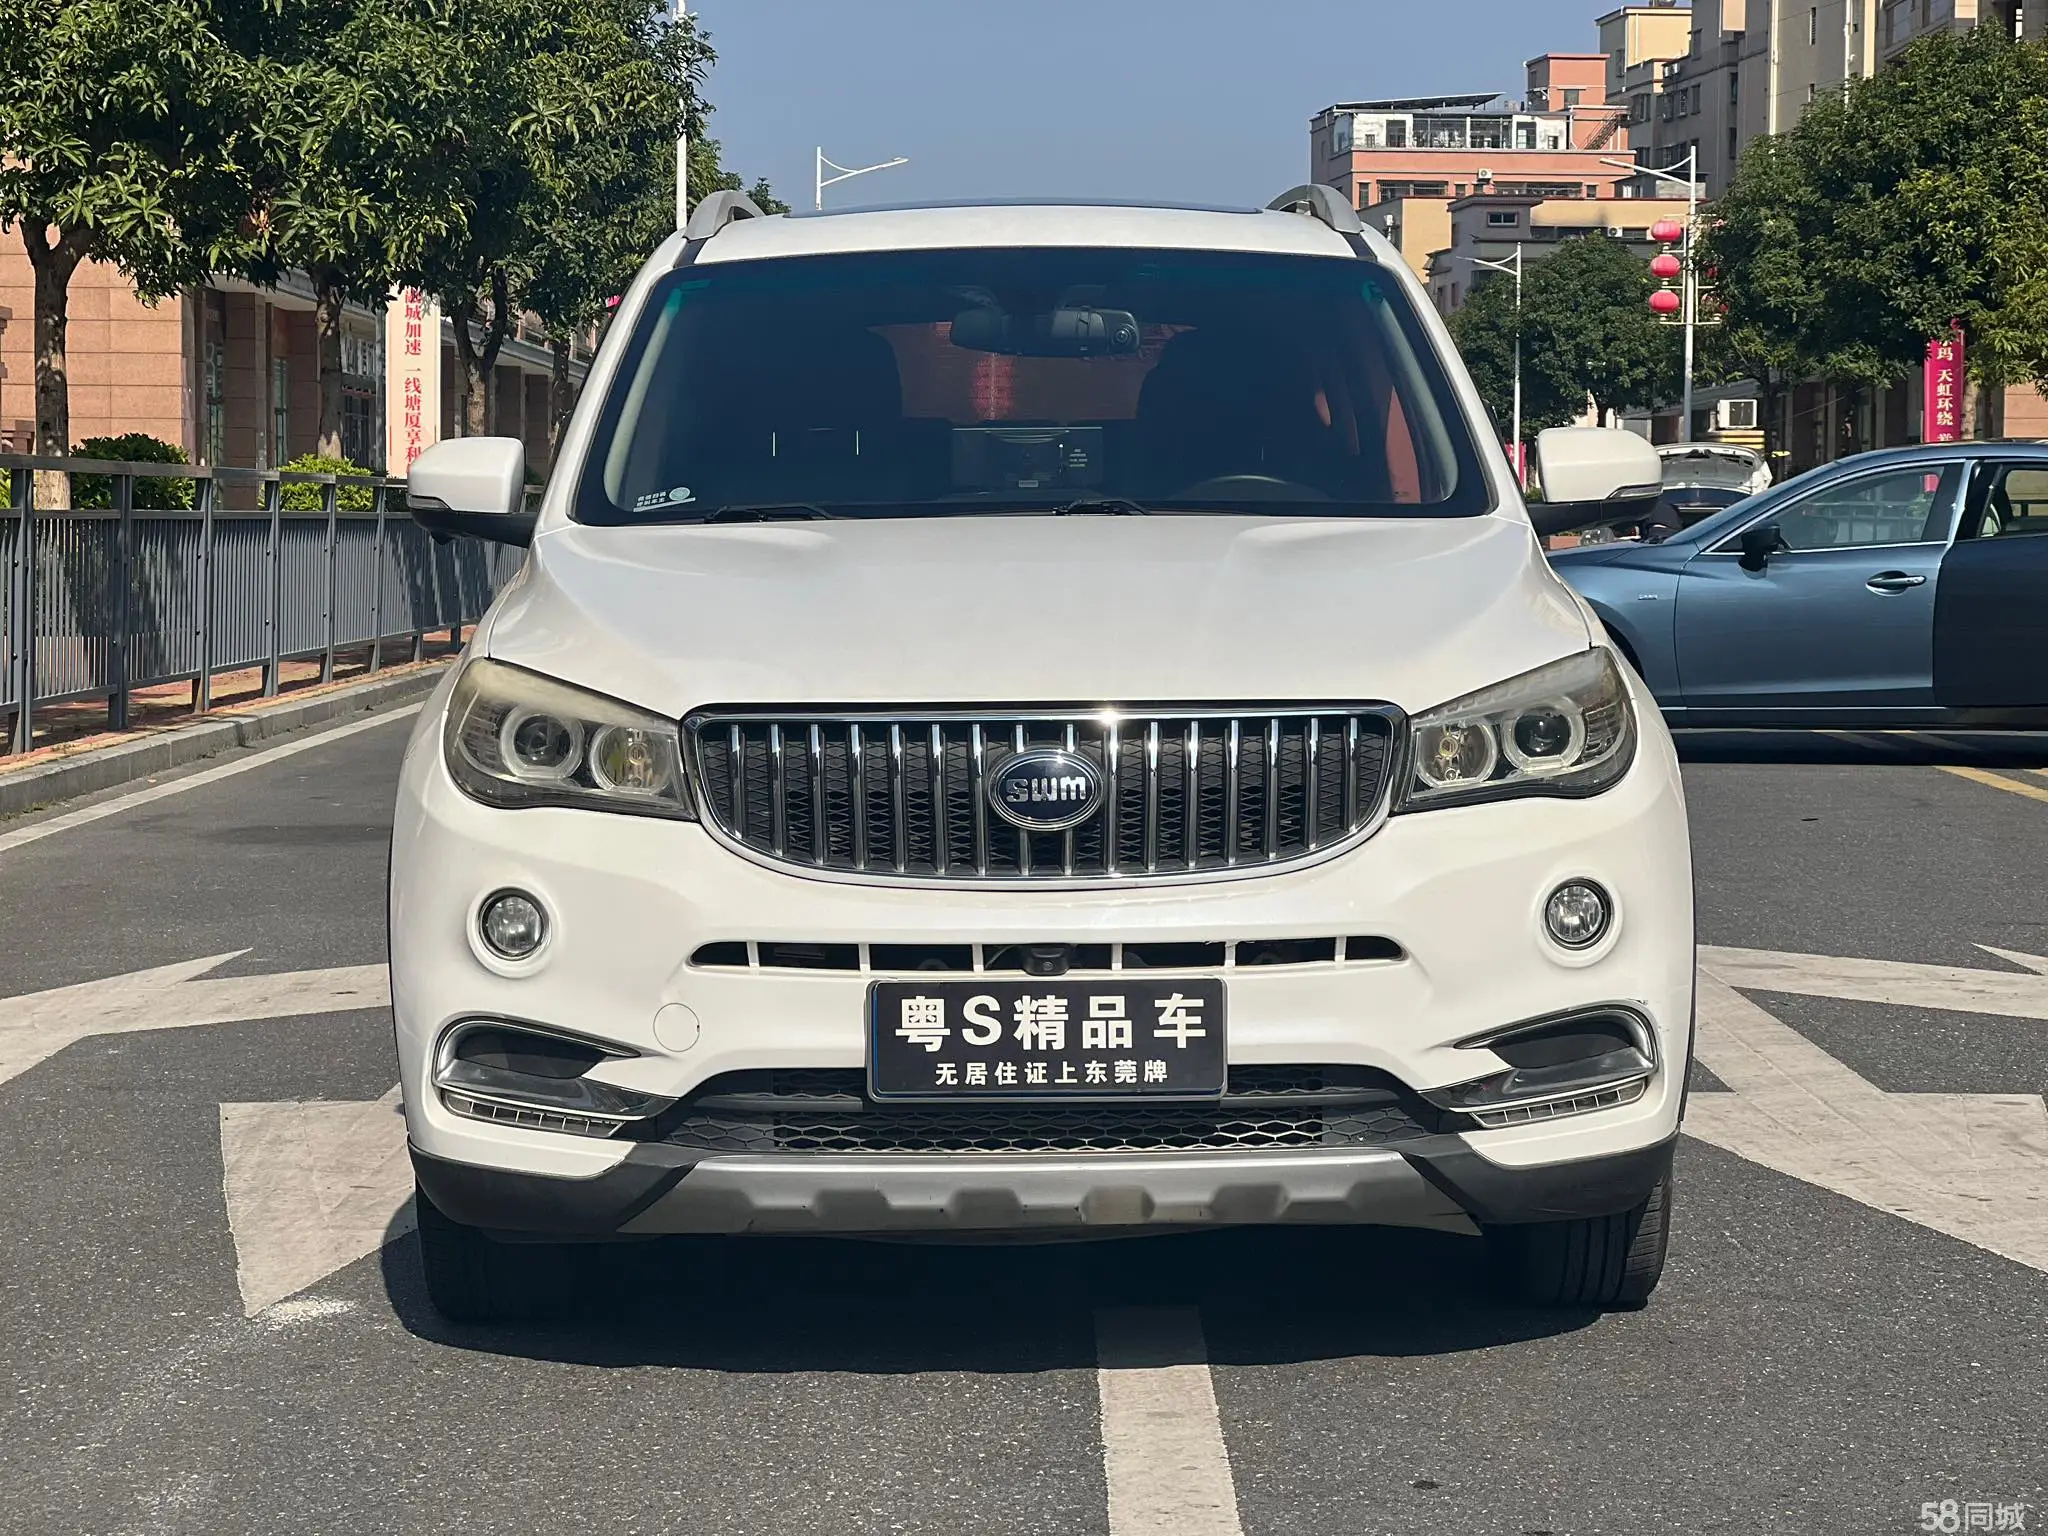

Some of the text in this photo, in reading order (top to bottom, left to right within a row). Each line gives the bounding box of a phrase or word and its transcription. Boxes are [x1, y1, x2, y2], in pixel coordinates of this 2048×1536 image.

[895, 993, 1207, 1052] 粤S精品车
[935, 1059, 1168, 1086] 无居住证上东莞牌
